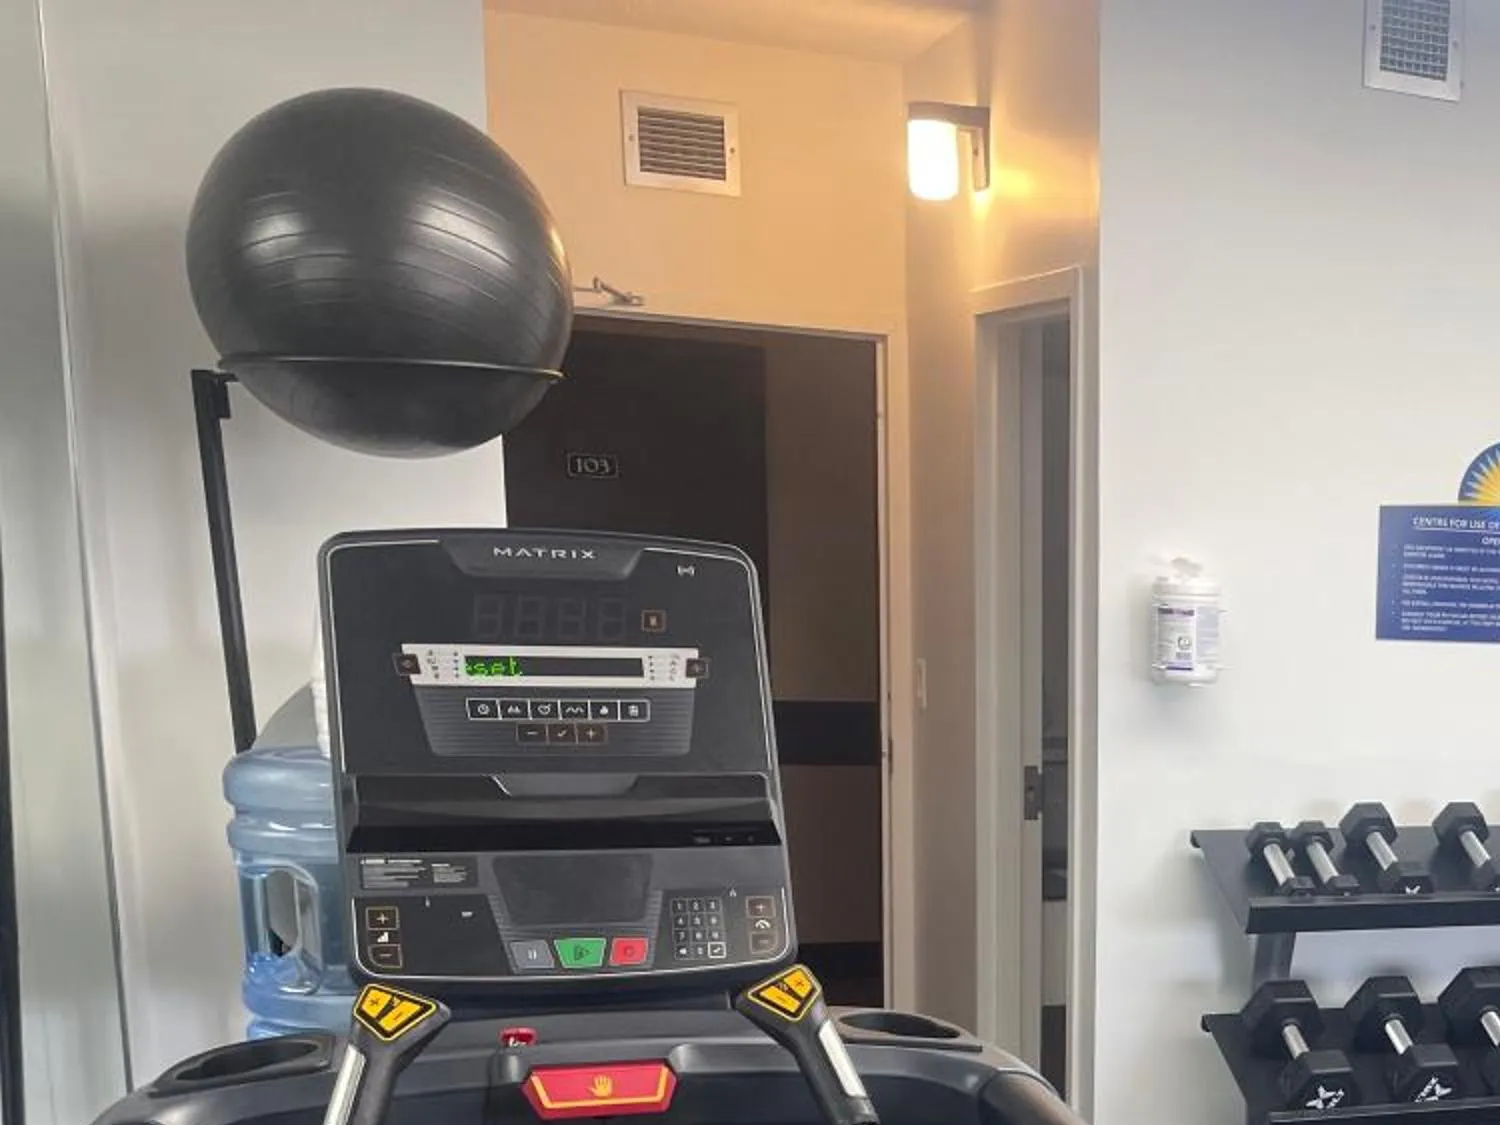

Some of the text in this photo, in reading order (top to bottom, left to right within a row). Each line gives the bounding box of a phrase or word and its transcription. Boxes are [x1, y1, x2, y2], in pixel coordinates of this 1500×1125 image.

[1449, 518, 1468, 528] FOR
[1469, 519, 1486, 529] USE
[493, 546, 596, 559] MATRIX
